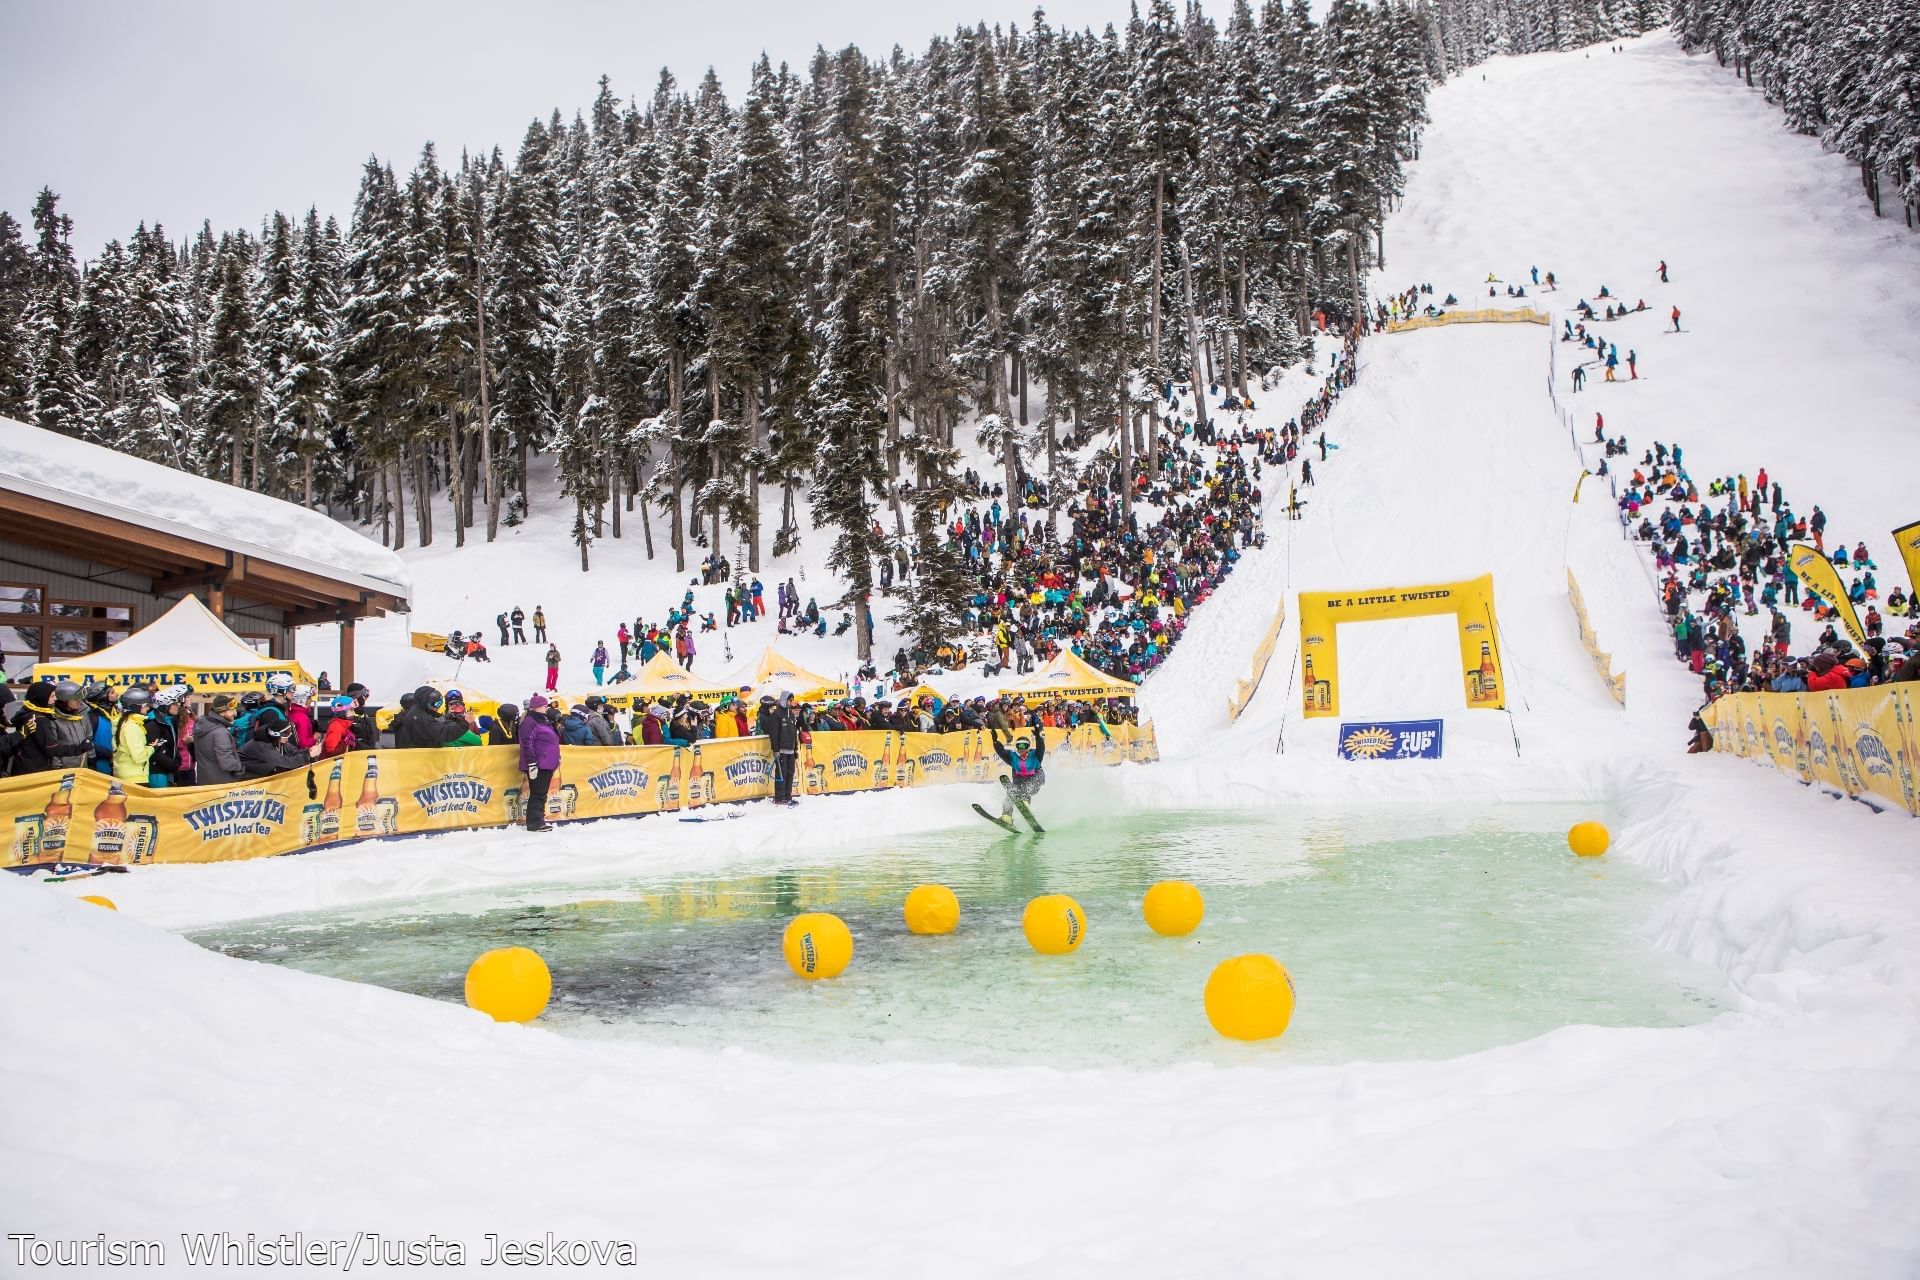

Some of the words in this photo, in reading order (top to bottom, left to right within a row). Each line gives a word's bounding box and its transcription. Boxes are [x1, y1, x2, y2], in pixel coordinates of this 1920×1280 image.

[1358, 595, 1396, 605] LITTLE
[1401, 590, 1450, 601] TWISTED
[108, 673, 186, 685] LITTLE
[698, 691, 738, 699] TWISTED
[1027, 691, 1058, 699] LITTLE
[1063, 687, 1103, 696] TWISTED
[1401, 734, 1432, 752] CUP
[833, 755, 856, 772] TWISTED
[856, 754, 867, 772] TEA
[919, 752, 942, 767] TWISTED
[725, 759, 761, 780] TWISTED
[588, 769, 633, 793] TWISTED
[632, 769, 648, 789] TEA
[413, 781, 470, 808] TWISTED
[469, 781, 491, 804] TEA
[599, 790, 614, 799] Hard
[183, 800, 263, 830] TWISTED
[263, 799, 285, 824] TEA
[427, 803, 447, 816] Hard
[448, 802, 465, 811] Iced
[466, 802, 477, 812] Tea
[95, 830, 118, 839] TWISTED
[203, 824, 231, 840] Hard
[234, 823, 254, 834] Iced
[255, 822, 271, 835] Tea
[133, 838, 145, 863] TWISTED
[139, 826, 147, 838] TEA
[803, 933, 815, 962] TWISTED
